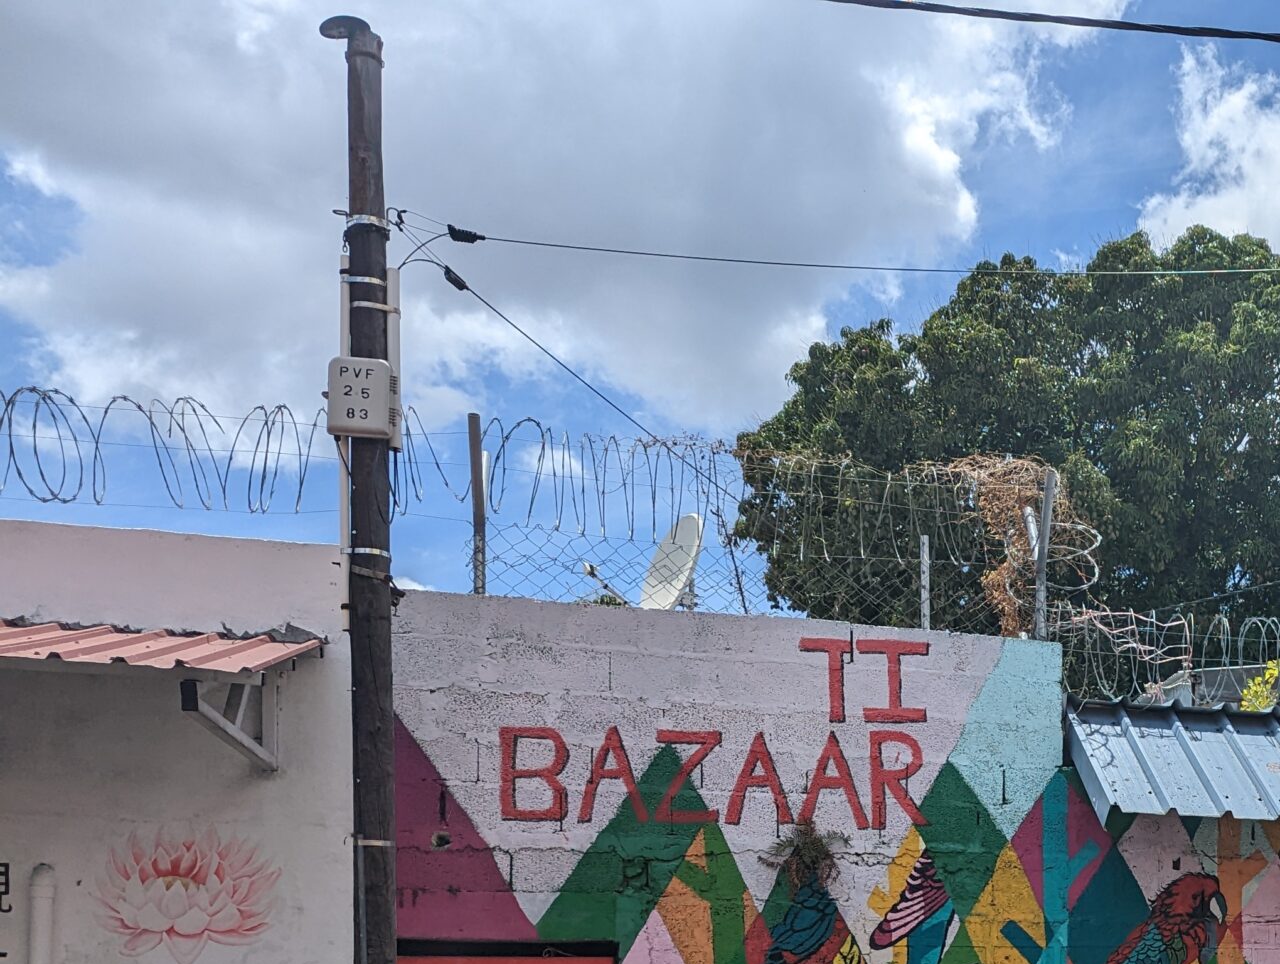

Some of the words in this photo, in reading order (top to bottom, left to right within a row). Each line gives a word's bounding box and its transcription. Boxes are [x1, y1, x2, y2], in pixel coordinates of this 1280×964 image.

[340, 366, 375, 379] PVF
[343, 384, 370, 399] 25
[346, 407, 368, 419] 83
[799, 637, 929, 723] TI
[499, 725, 928, 830] BAZAAR
